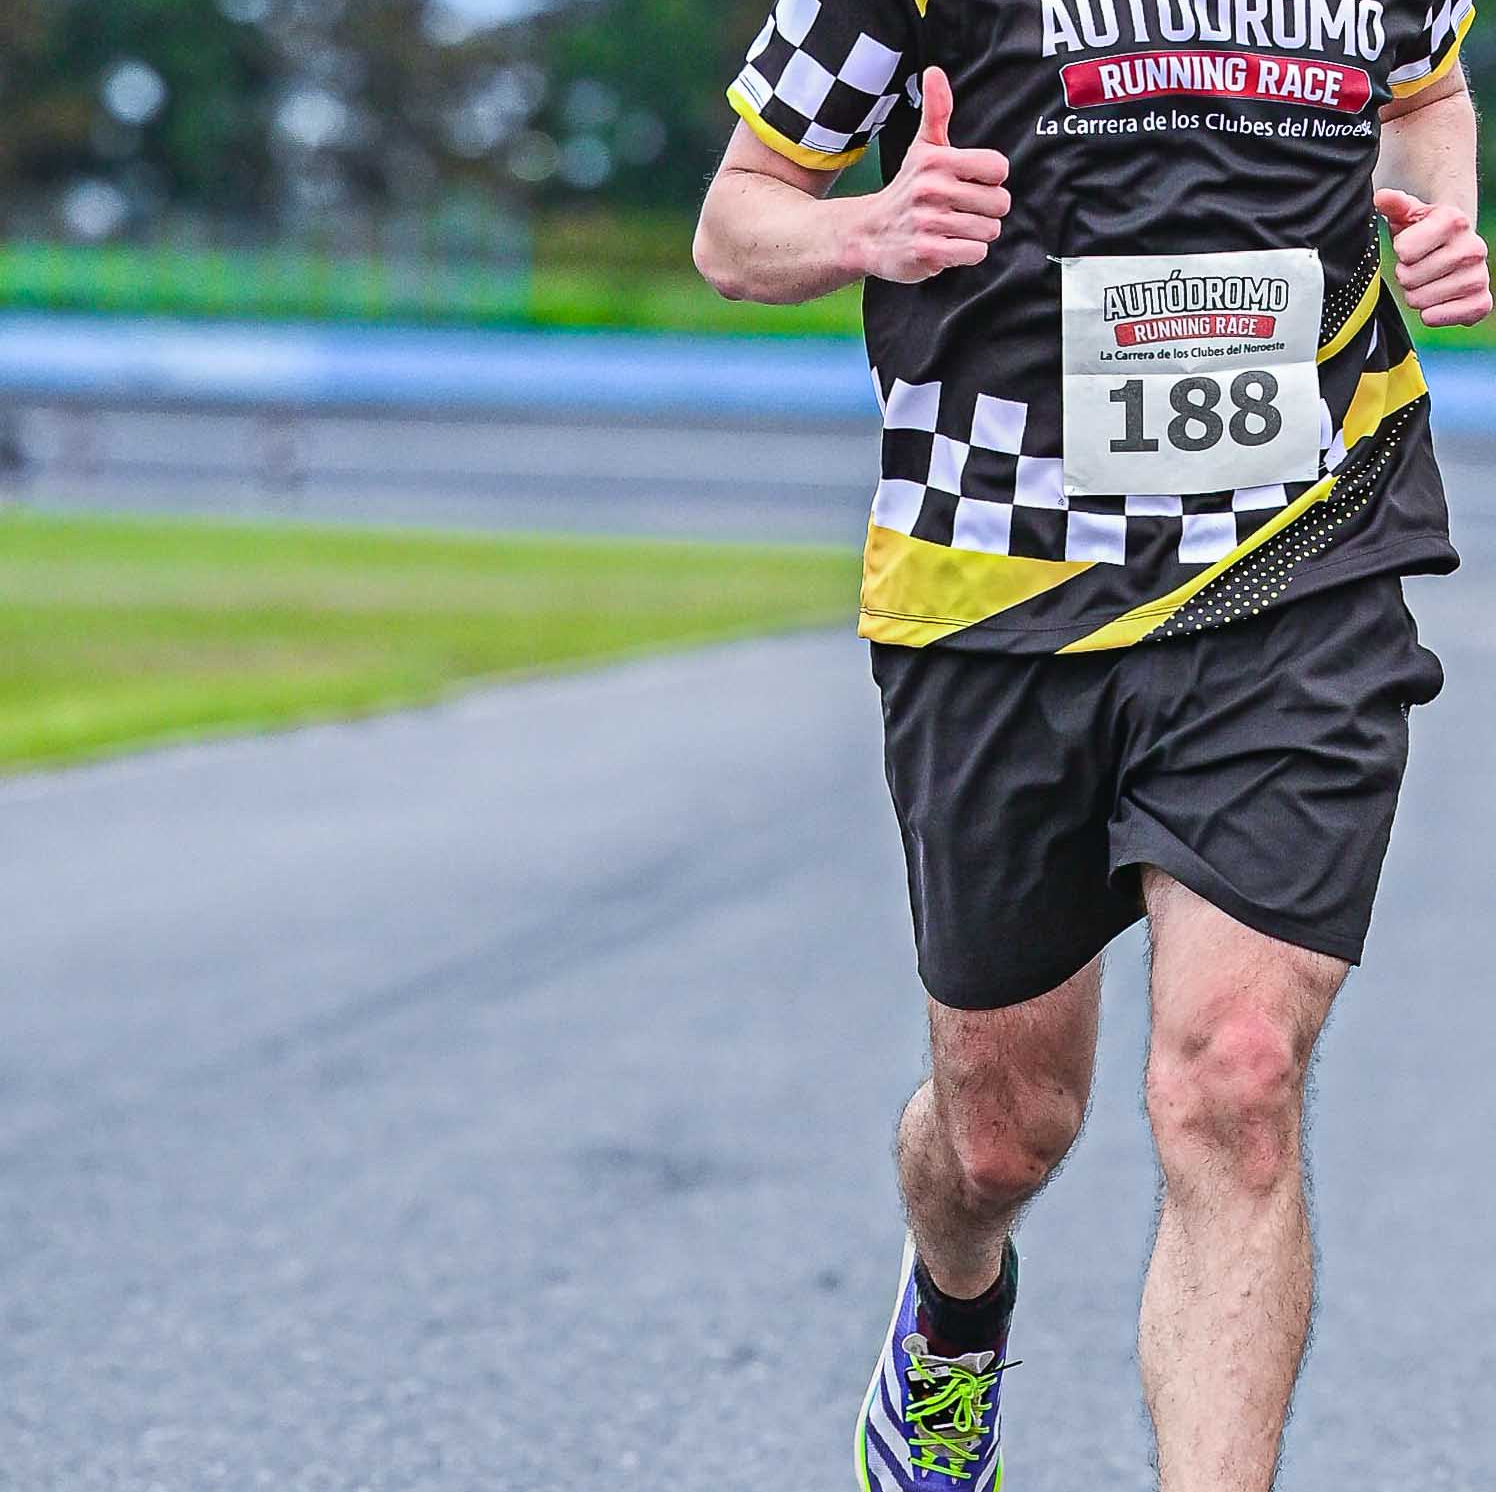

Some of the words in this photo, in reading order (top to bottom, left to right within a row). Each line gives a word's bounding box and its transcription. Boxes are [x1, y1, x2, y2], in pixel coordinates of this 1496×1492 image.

[1098, 56, 1246, 100] RUNNING
[1256, 58, 1344, 105] RACE
[1036, 115, 1058, 135] La
[1063, 114, 1138, 135] Carrera
[1143, 111, 1167, 131] de
[1172, 109, 1200, 129] los
[1205, 113, 1274, 137] Clubes
[1277, 117, 1308, 137] del
[1104, 270, 1288, 321] AUTÓDROMO
[1134, 316, 1210, 343] RUNNING
[1215, 316, 1257, 337] RACE
[1100, 350, 1113, 361] La
[1114, 350, 1155, 361] Carrera
[1157, 348, 1171, 360] de
[1173, 348, 1189, 359] los
[1190, 346, 1225, 358] Clubes
[1226, 344, 1242, 356] del
[1243, 341, 1285, 354] Noroeste
[1109, 370, 1282, 453] 188
